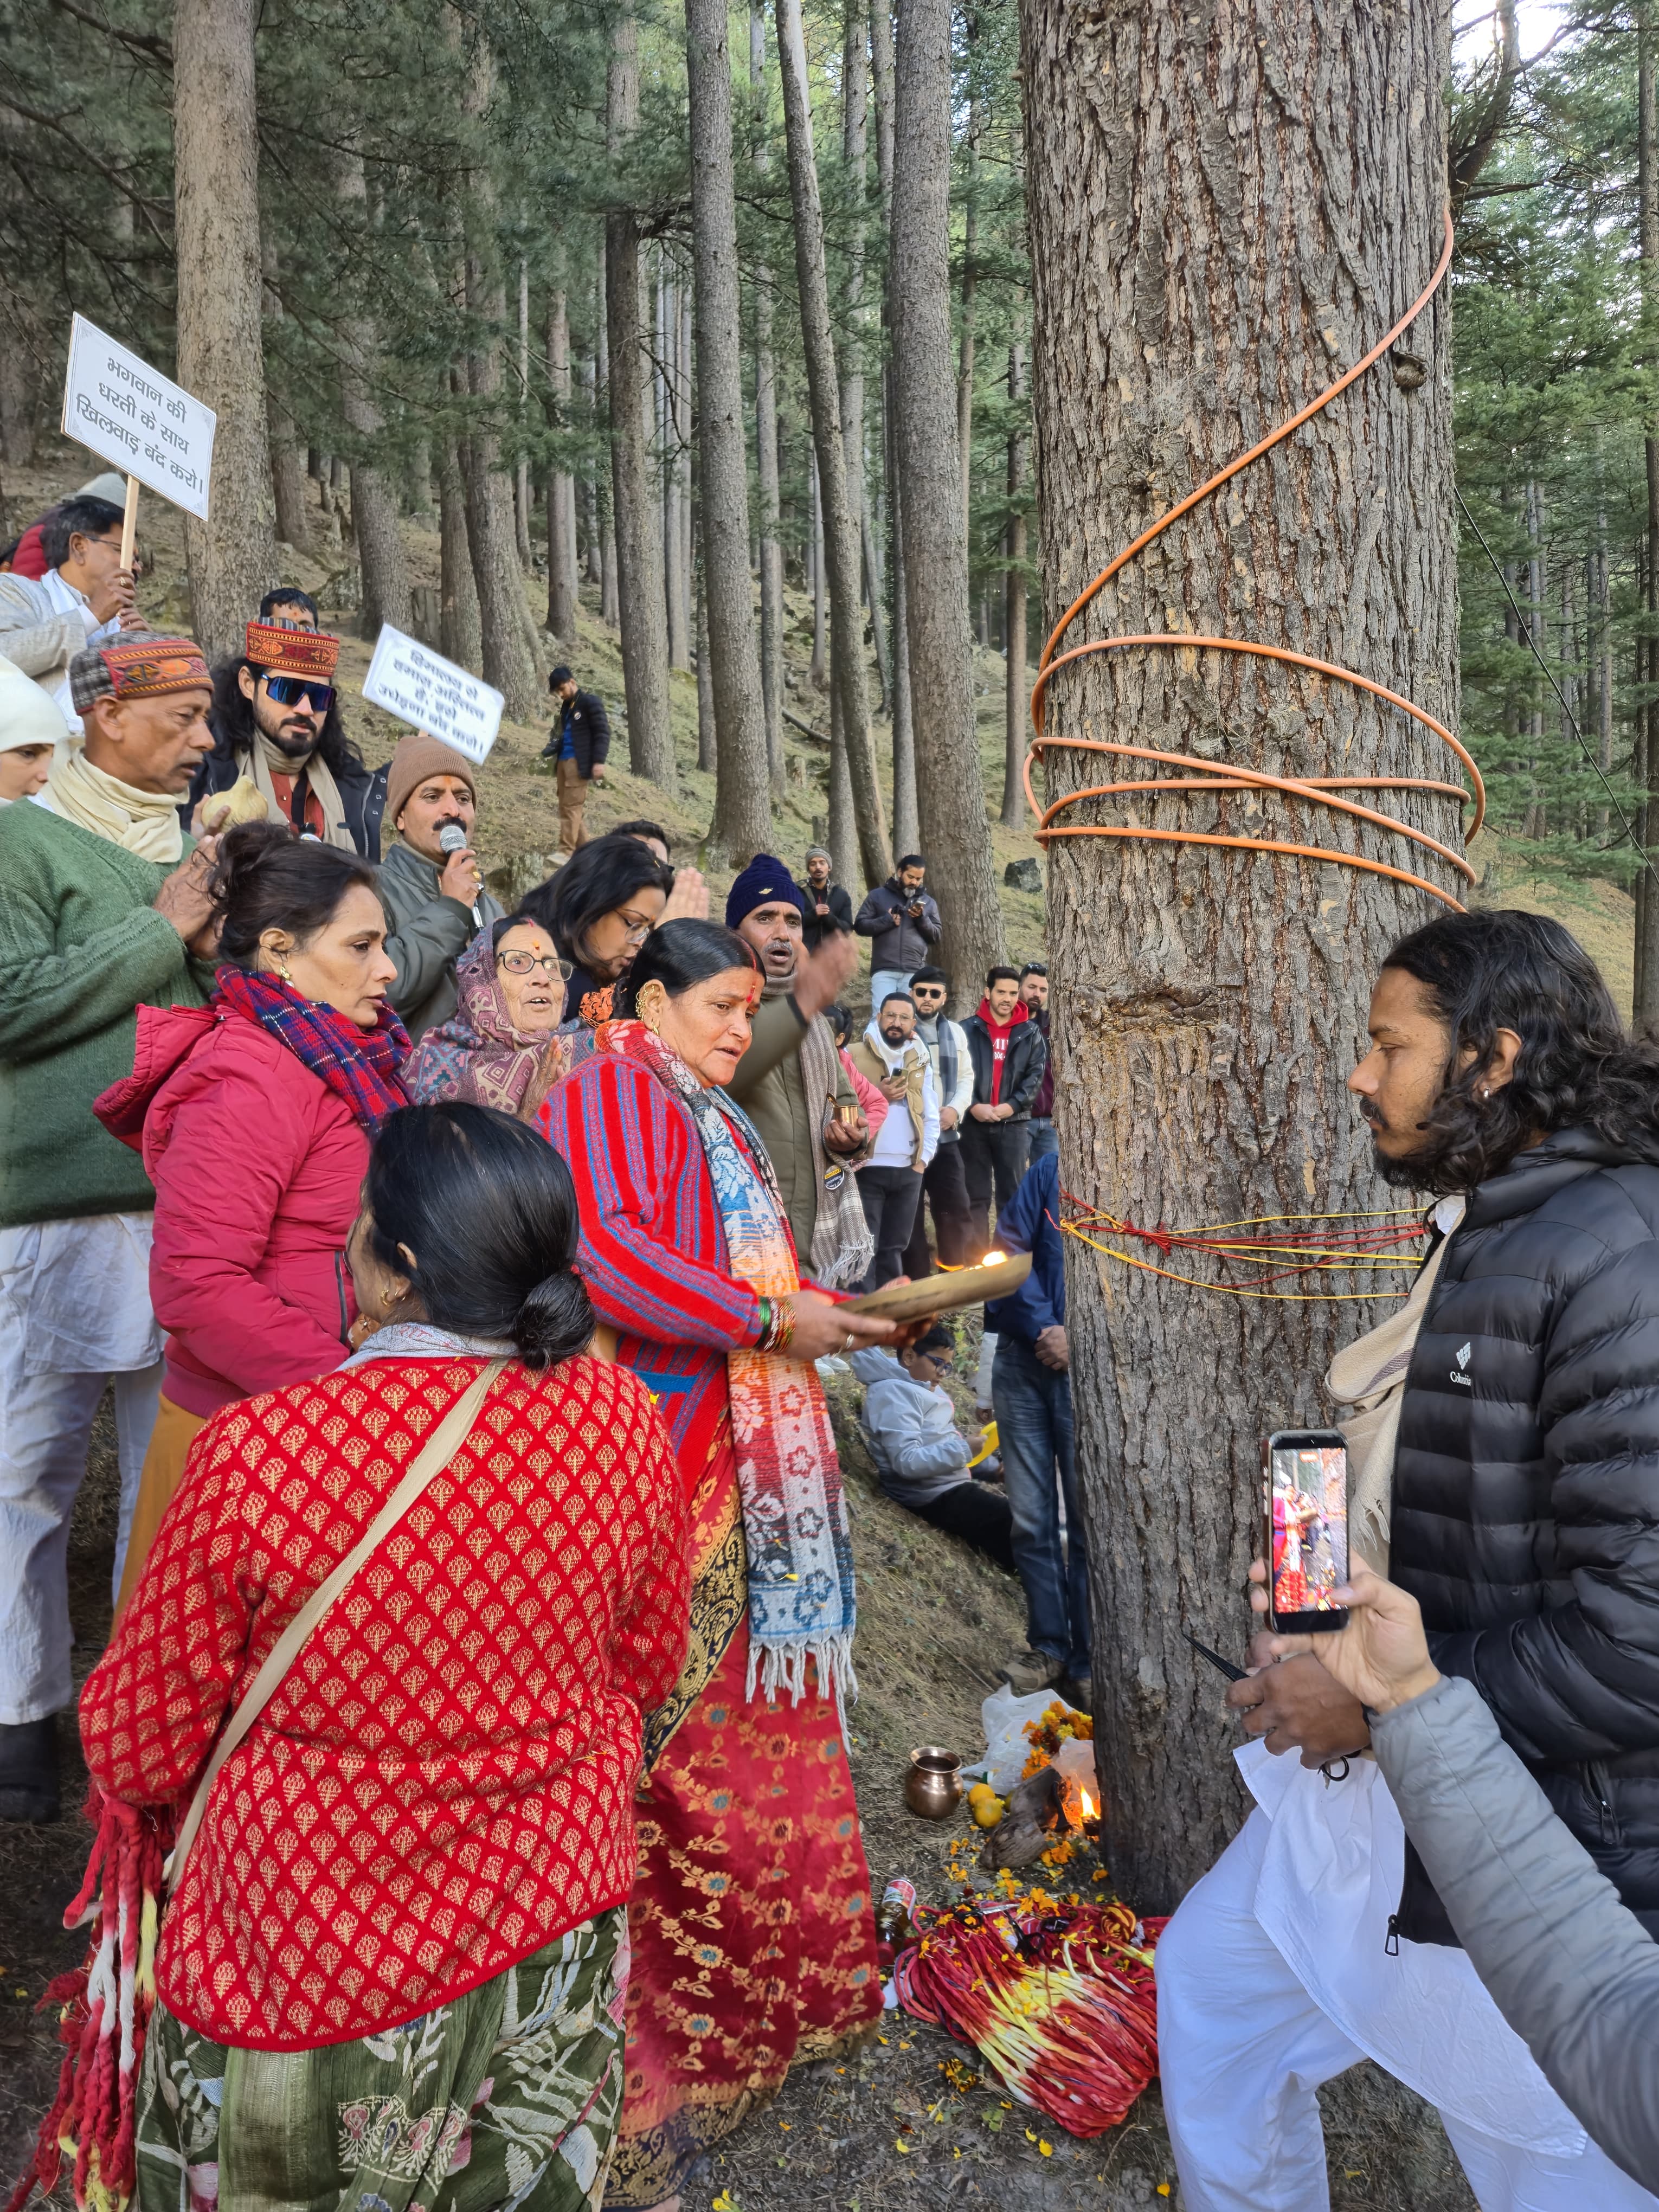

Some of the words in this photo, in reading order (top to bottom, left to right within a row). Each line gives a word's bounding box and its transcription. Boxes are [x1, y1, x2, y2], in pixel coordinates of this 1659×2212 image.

[99, 382, 137, 419] धरती
[140, 409, 157, 430] के
[160, 423, 190, 455] साथ
[107, 357, 163, 407] भगवान
[166, 397, 187, 423] की
[76, 393, 141, 455] खिलवाड़
[144, 442, 167, 468] बंद
[410, 650, 462, 691] हिमालय
[1450, 1371, 1471, 1387] Columbia
